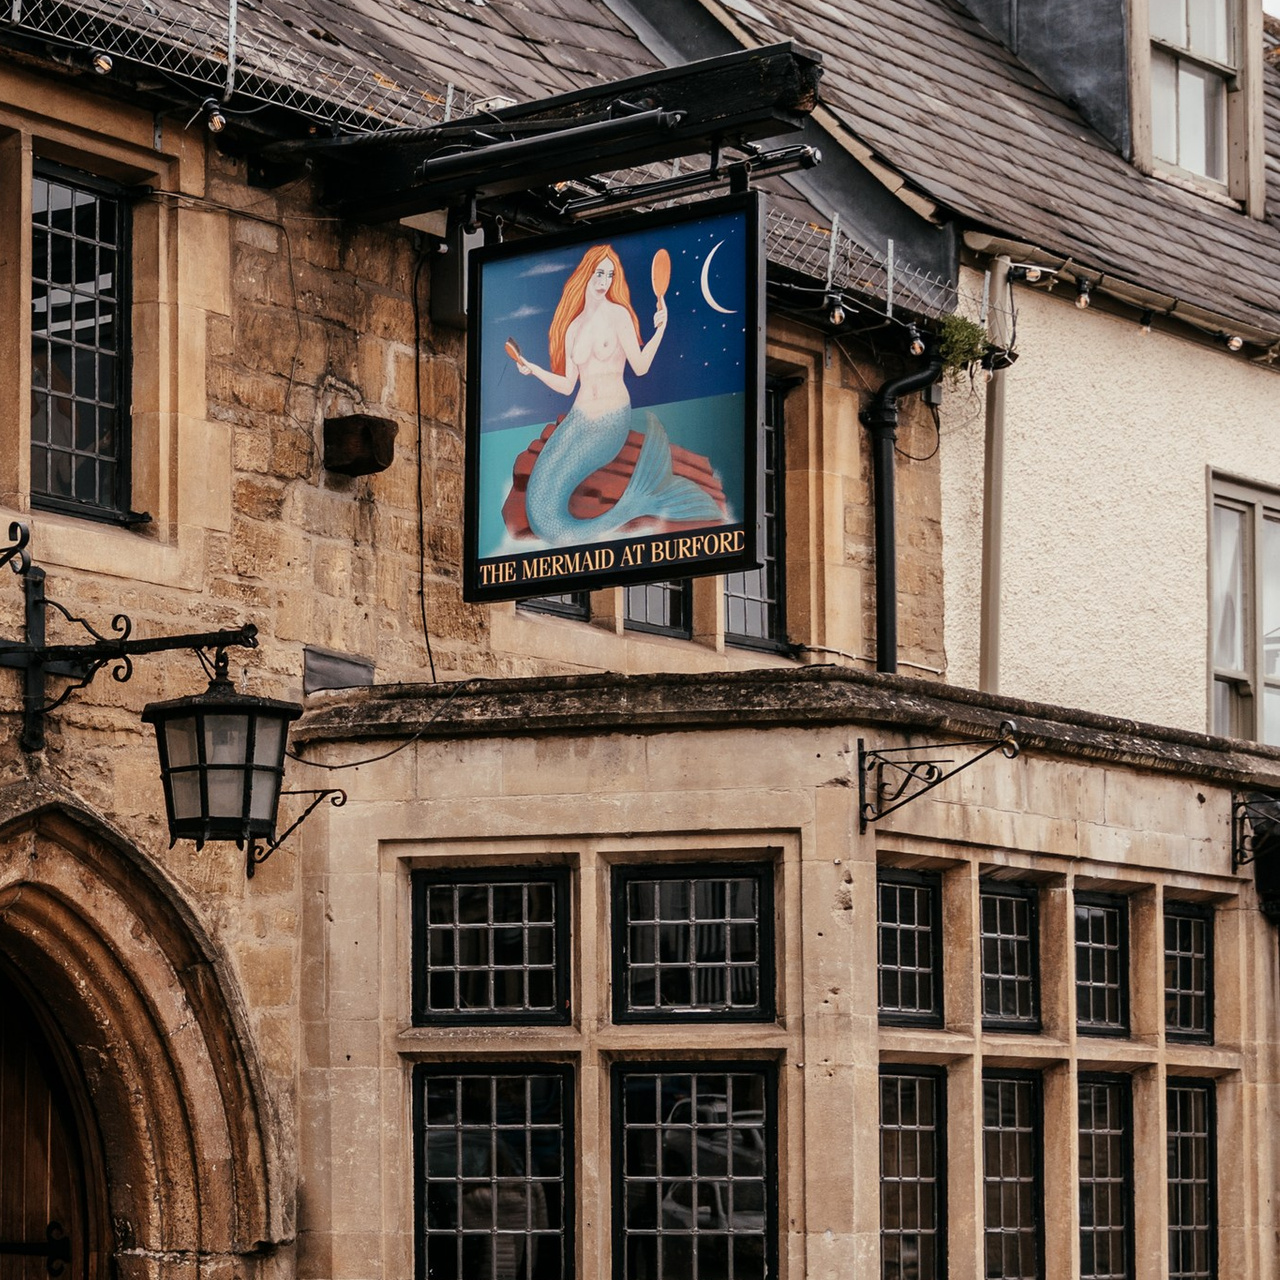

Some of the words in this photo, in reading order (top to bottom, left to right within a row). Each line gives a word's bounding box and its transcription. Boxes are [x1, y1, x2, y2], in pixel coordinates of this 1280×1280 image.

[479, 561, 517, 585] THE
[522, 548, 615, 580] MERMAID
[620, 543, 646, 567] AT
[650, 530, 745, 563] BURFORD
